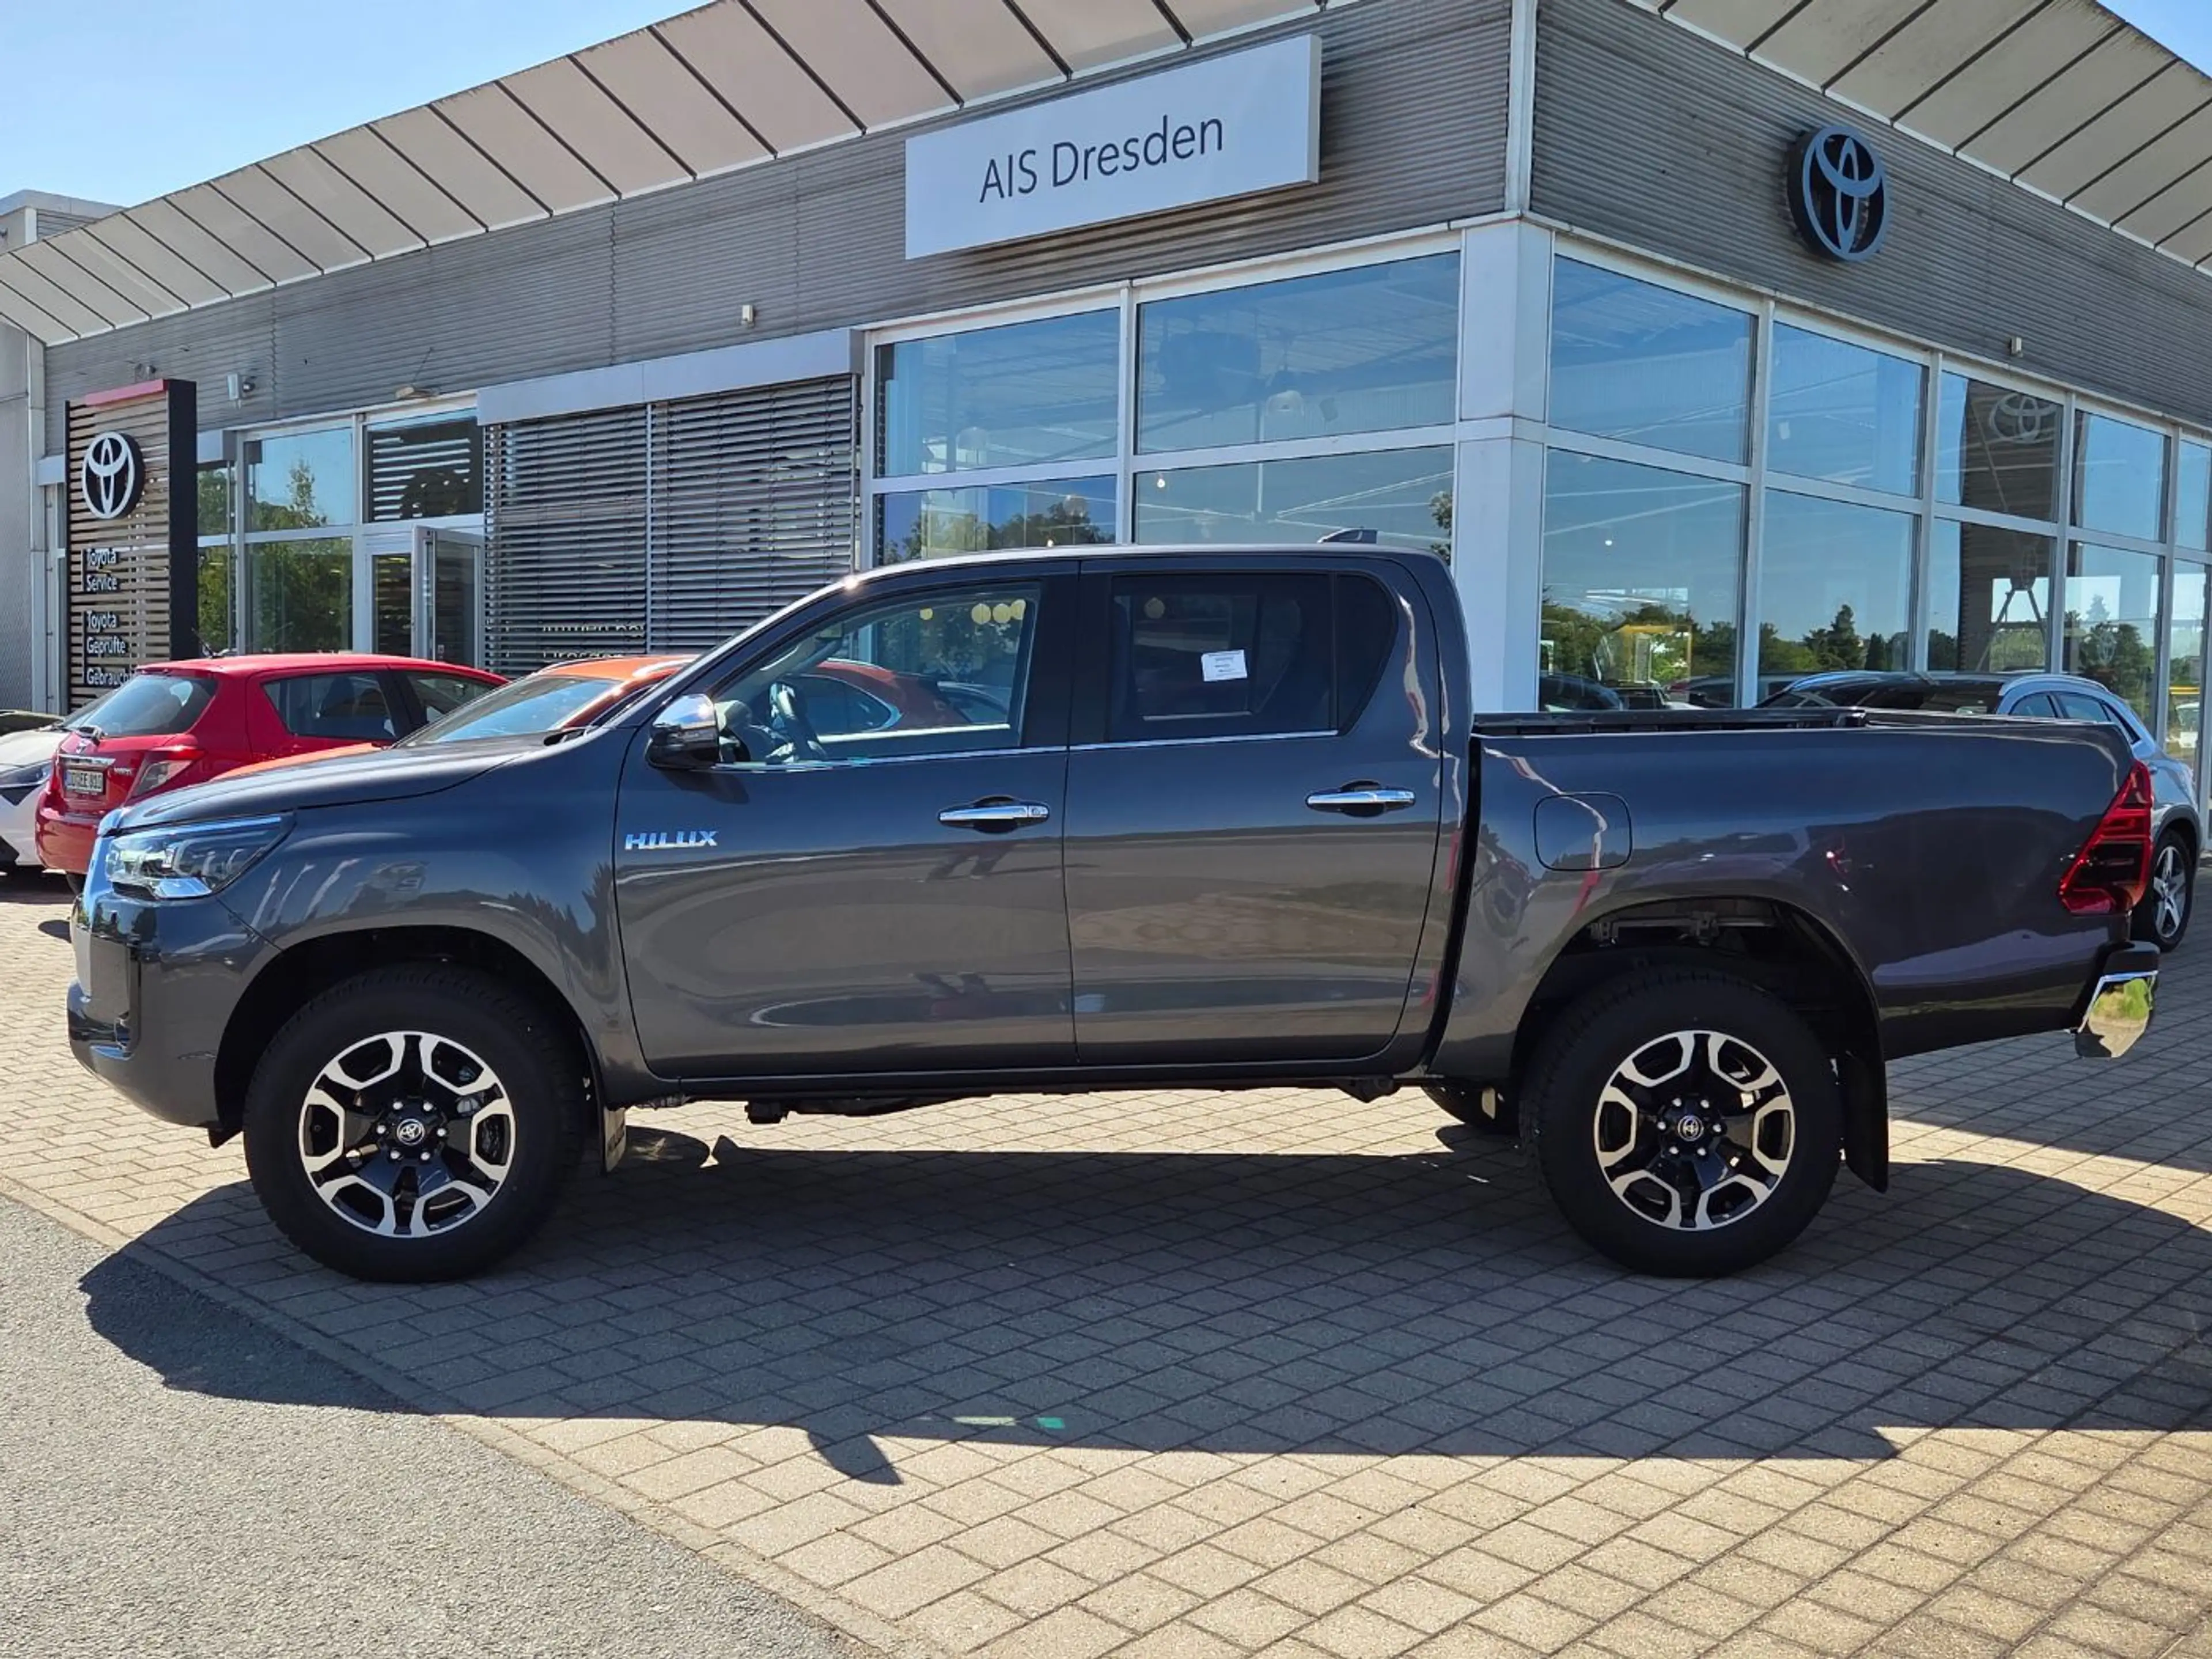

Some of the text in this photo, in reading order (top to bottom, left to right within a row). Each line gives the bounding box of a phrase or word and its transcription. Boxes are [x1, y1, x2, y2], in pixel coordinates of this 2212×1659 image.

[979, 114, 1224, 203] AIS Dresden
[86, 548, 117, 570] Toyota
[86, 574, 118, 592] Service
[86, 610, 116, 633] Toyota
[625, 830, 718, 850] HILUX
